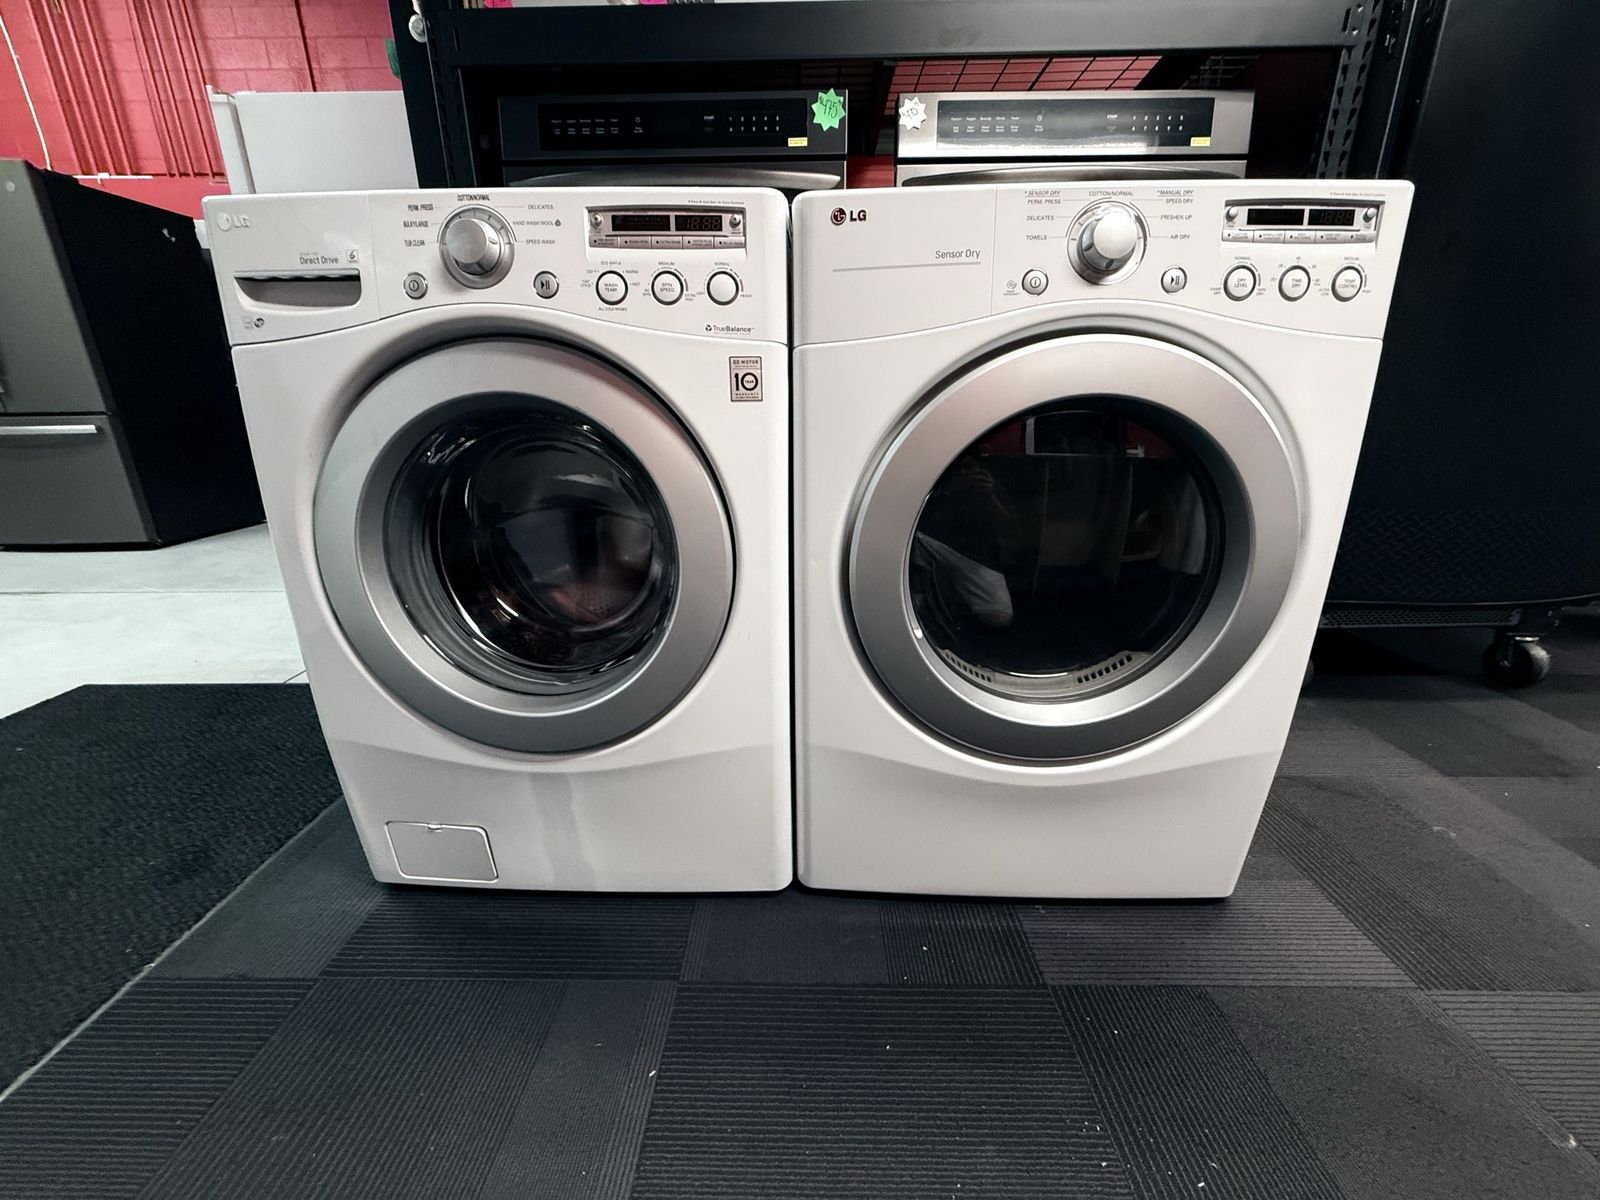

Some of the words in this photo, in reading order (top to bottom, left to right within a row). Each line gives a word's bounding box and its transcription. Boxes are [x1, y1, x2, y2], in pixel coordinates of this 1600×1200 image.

[420, 203, 434, 211] PRESS
[232, 213, 250, 229] LG
[849, 209, 867, 222] LG
[412, 239, 426, 247] CLEAN
[935, 250, 964, 260] Sensor
[964, 249, 981, 260] Dry
[300, 257, 321, 265] Direct
[321, 256, 340, 265] Drive
[734, 372, 759, 391] 10
